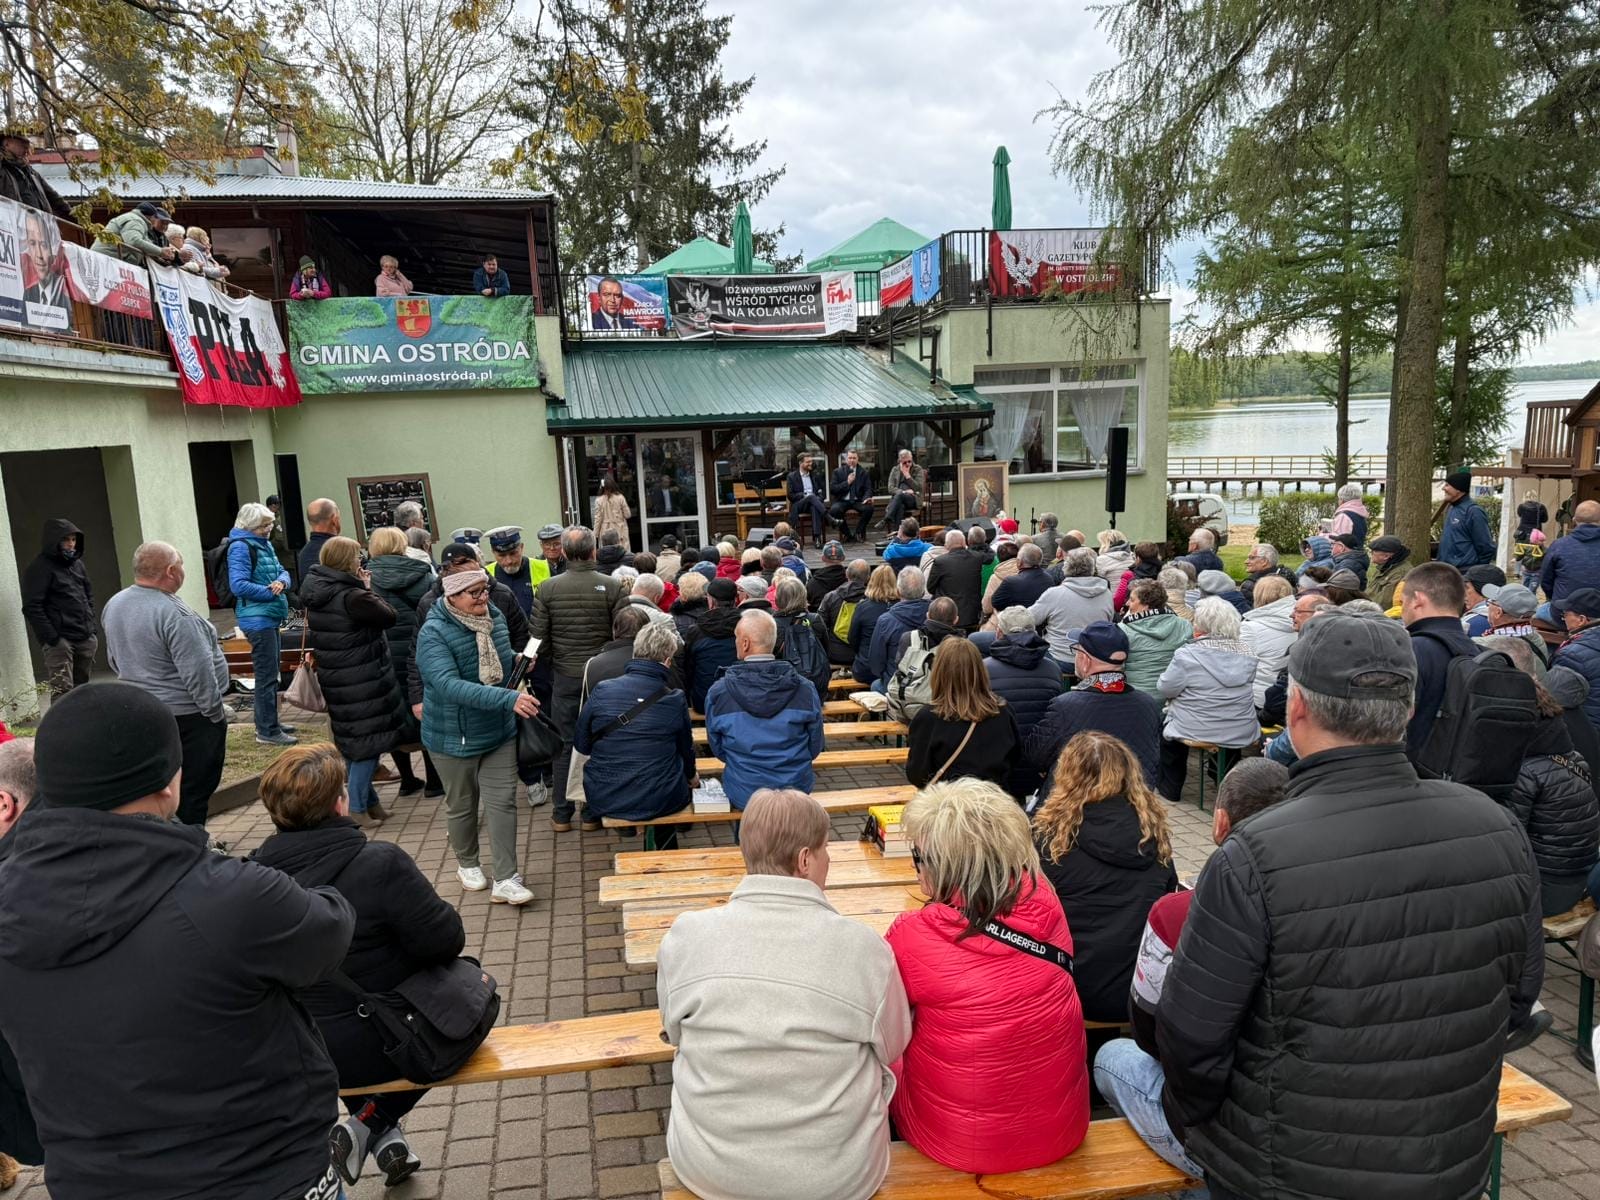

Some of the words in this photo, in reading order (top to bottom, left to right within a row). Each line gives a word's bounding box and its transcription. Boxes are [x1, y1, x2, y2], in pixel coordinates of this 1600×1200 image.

[1073, 240, 1097, 250] KLUB
[1048, 252, 1081, 262] GAZETY
[741, 283, 816, 295] WYPROSTOWANY
[725, 294, 767, 306] WŚRÓD
[769, 294, 797, 305] TYCH
[799, 294, 815, 304] CO
[623, 307, 665, 316] NAWROCKI
[727, 307, 745, 317] NA
[747, 304, 816, 317] KOLANACH
[300, 344, 391, 366] GMINA
[398, 337, 531, 363] OSTRÓDA
[343, 370, 493, 385] www.gminaostróda.pl
[1128, 608, 1160, 622] MOVING
[1000, 928, 1047, 955] LAGERFELD
